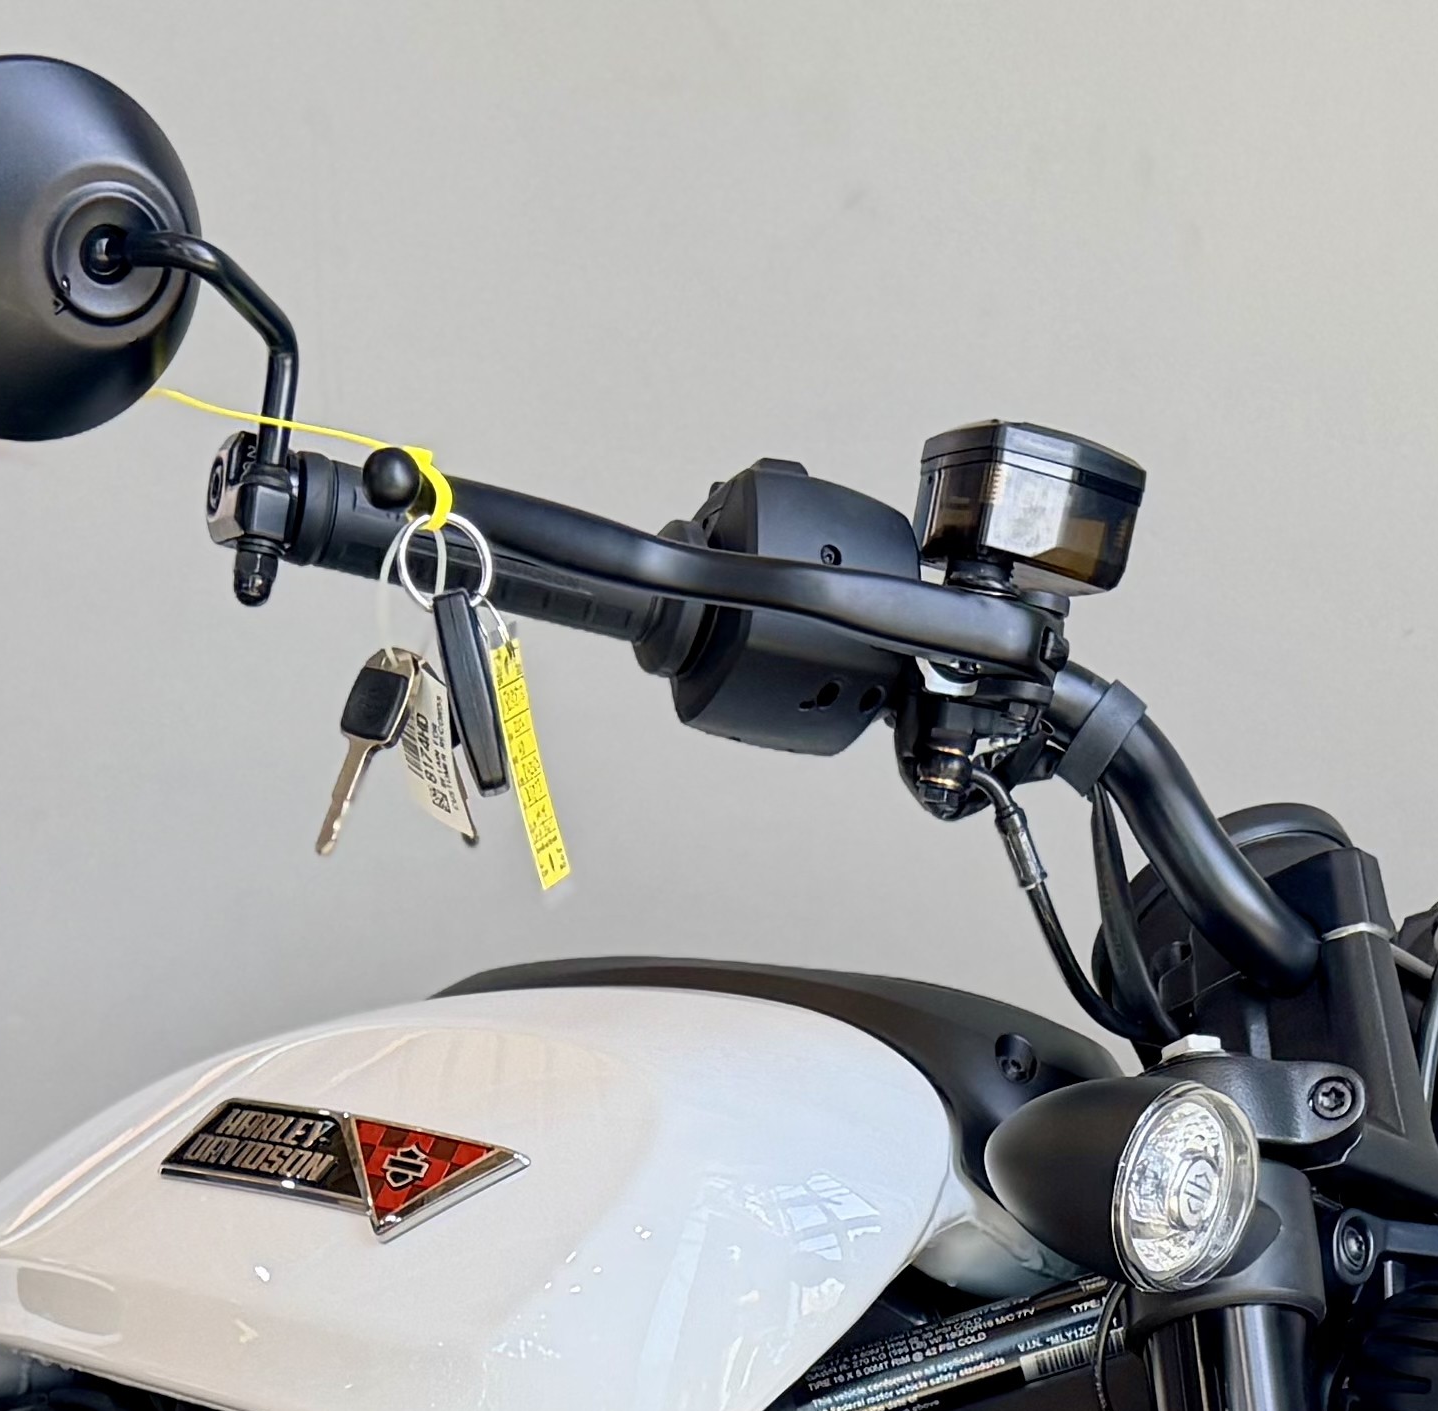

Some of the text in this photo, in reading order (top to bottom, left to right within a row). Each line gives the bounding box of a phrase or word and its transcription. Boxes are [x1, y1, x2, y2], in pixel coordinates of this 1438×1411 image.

[183, 1134, 337, 1182] DAVIDSON
[956, 1330, 987, 1347] COLD
[958, 1356, 1005, 1376] standards
[911, 1397, 940, 1411] above
